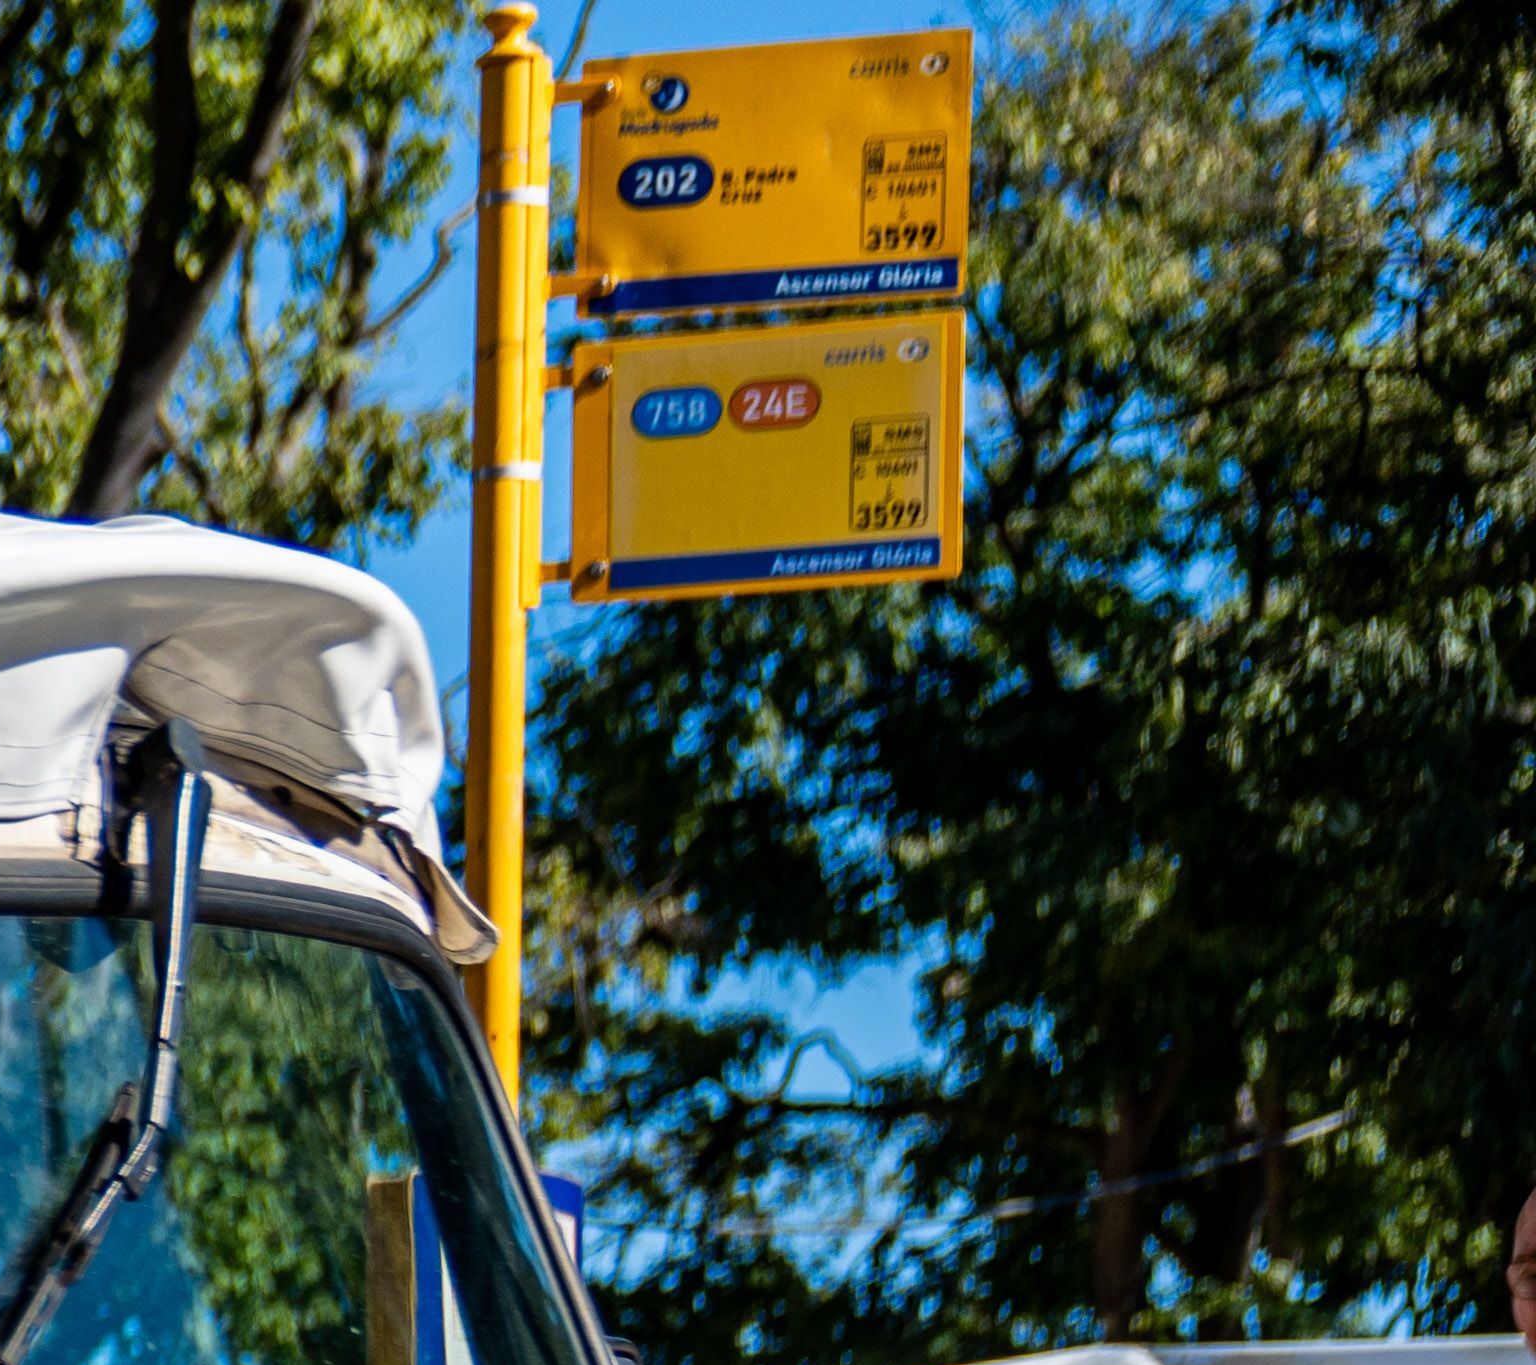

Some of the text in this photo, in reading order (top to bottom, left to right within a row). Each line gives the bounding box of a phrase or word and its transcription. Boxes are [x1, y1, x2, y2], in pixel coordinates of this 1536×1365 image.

[634, 162, 698, 200] 202
[775, 263, 944, 297] Ascensor Glória
[646, 396, 708, 431] 758
[742, 384, 807, 421] 24E
[771, 551, 867, 577] Ascensor
